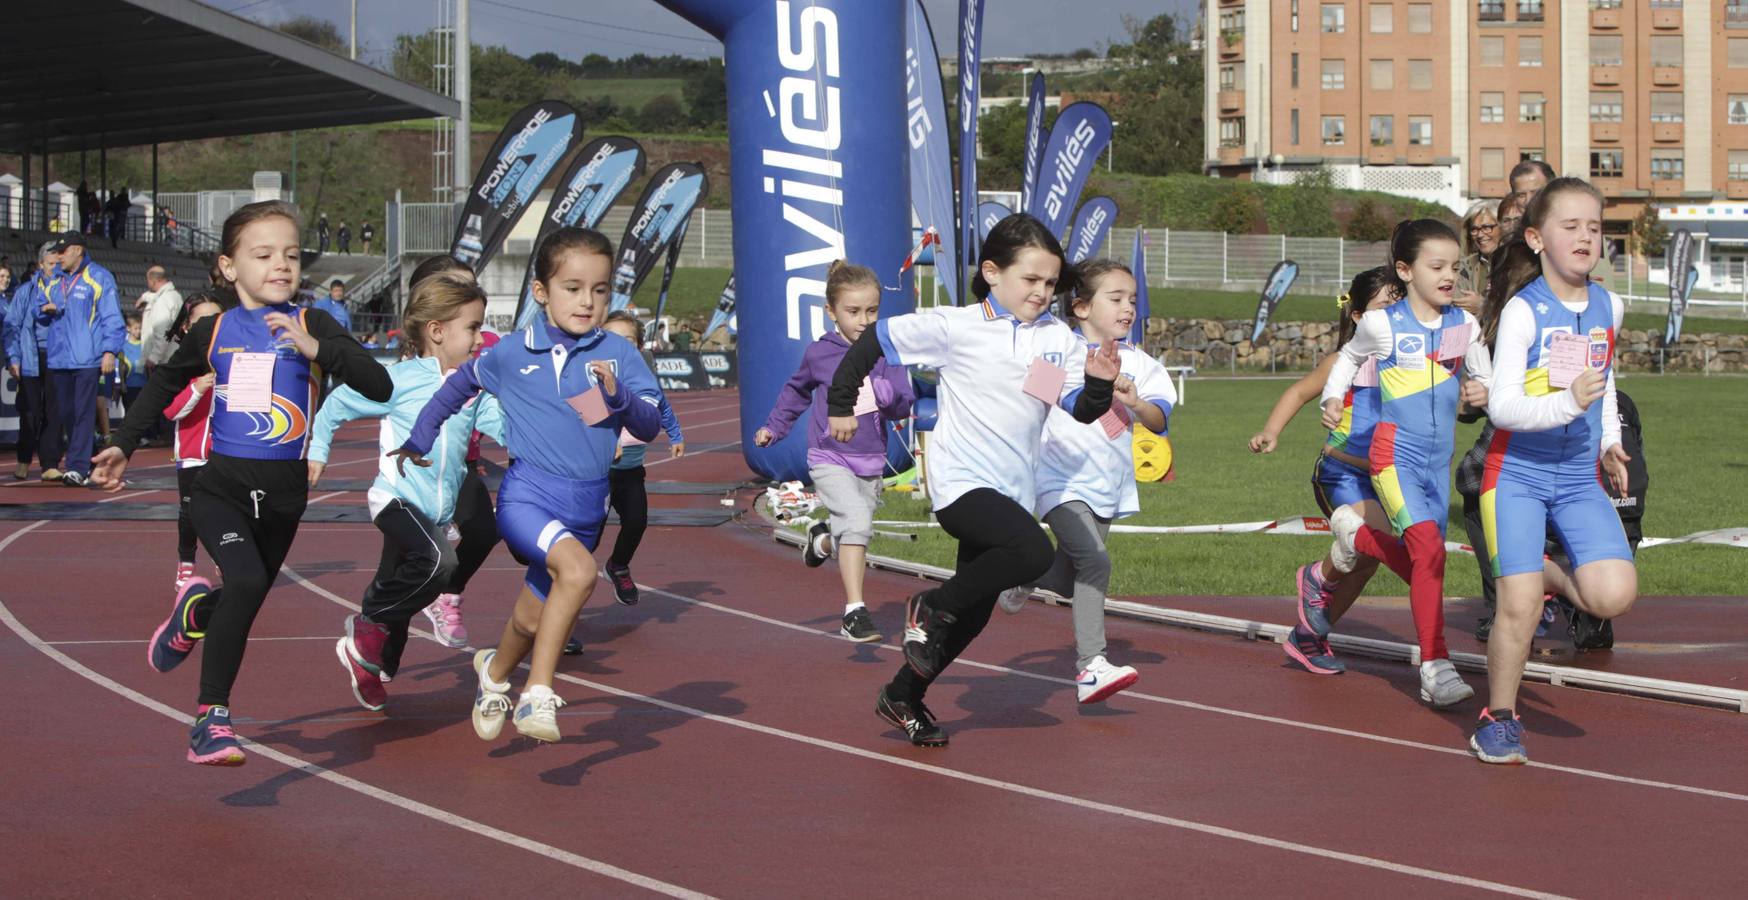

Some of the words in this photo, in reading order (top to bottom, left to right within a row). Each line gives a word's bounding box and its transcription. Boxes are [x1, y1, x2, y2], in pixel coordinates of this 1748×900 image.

[478, 109, 551, 199] POWERADE
[551, 143, 616, 223] POWERADE
[763, 0, 845, 340] avilés
[1044, 118, 1096, 221] avilés
[631, 168, 685, 238] POWERADE
[1074, 205, 1107, 263] avilés
